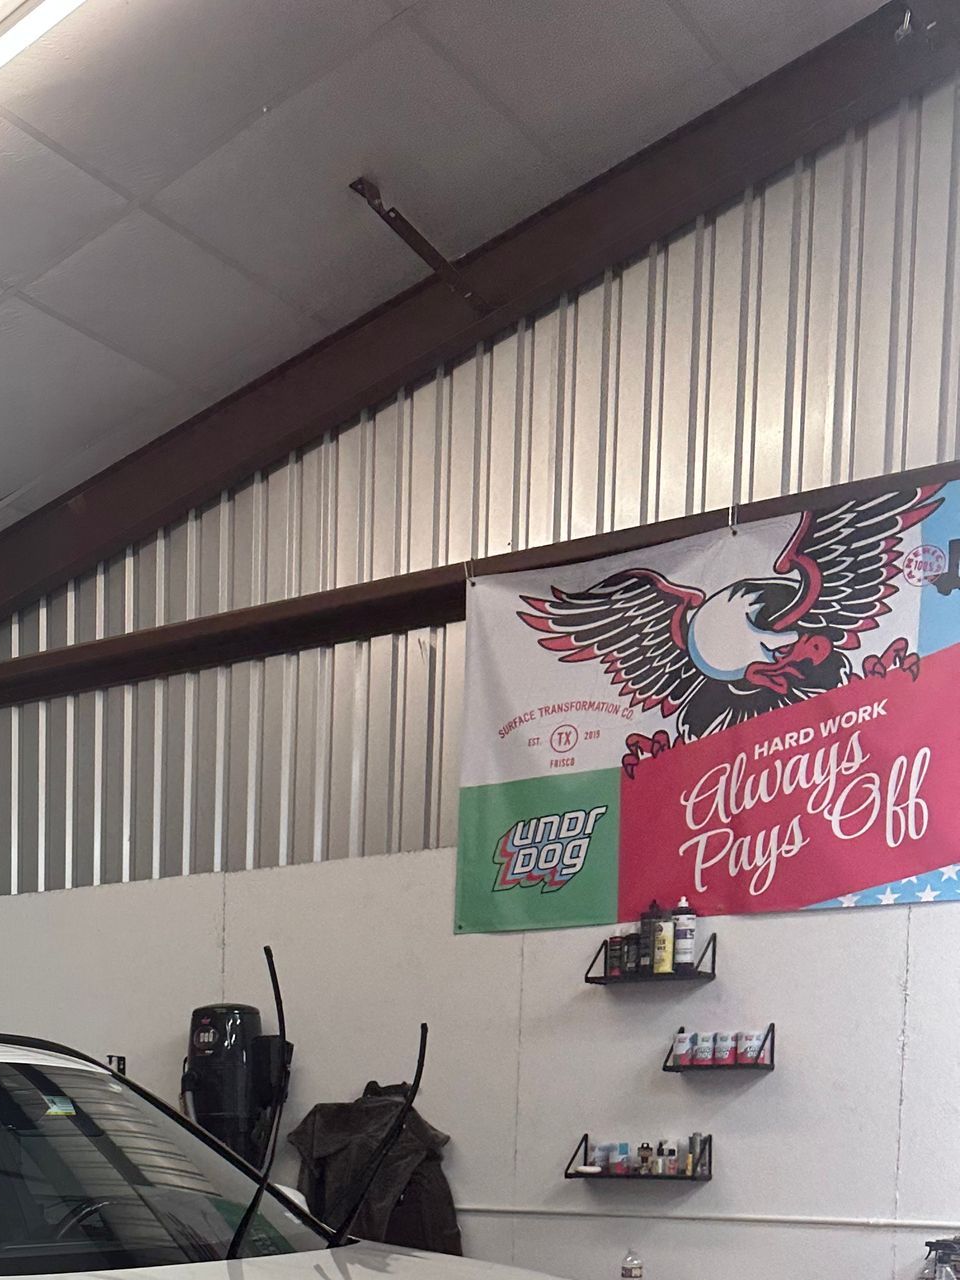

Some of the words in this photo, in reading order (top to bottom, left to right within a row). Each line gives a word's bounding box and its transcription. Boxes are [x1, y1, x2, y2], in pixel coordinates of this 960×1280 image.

[498, 710, 536, 739] SURFACE
[538, 700, 620, 716] TRANSFORMATION
[621, 707, 634, 721] CO.
[557, 731, 572, 746] TX
[753, 728, 815, 760] HARD
[819, 698, 888, 738] WORK
[550, 757, 576, 768] FRISCO
[679, 730, 870, 830] Always
[678, 814, 810, 896] Pays
[823, 746, 931, 848] Off
